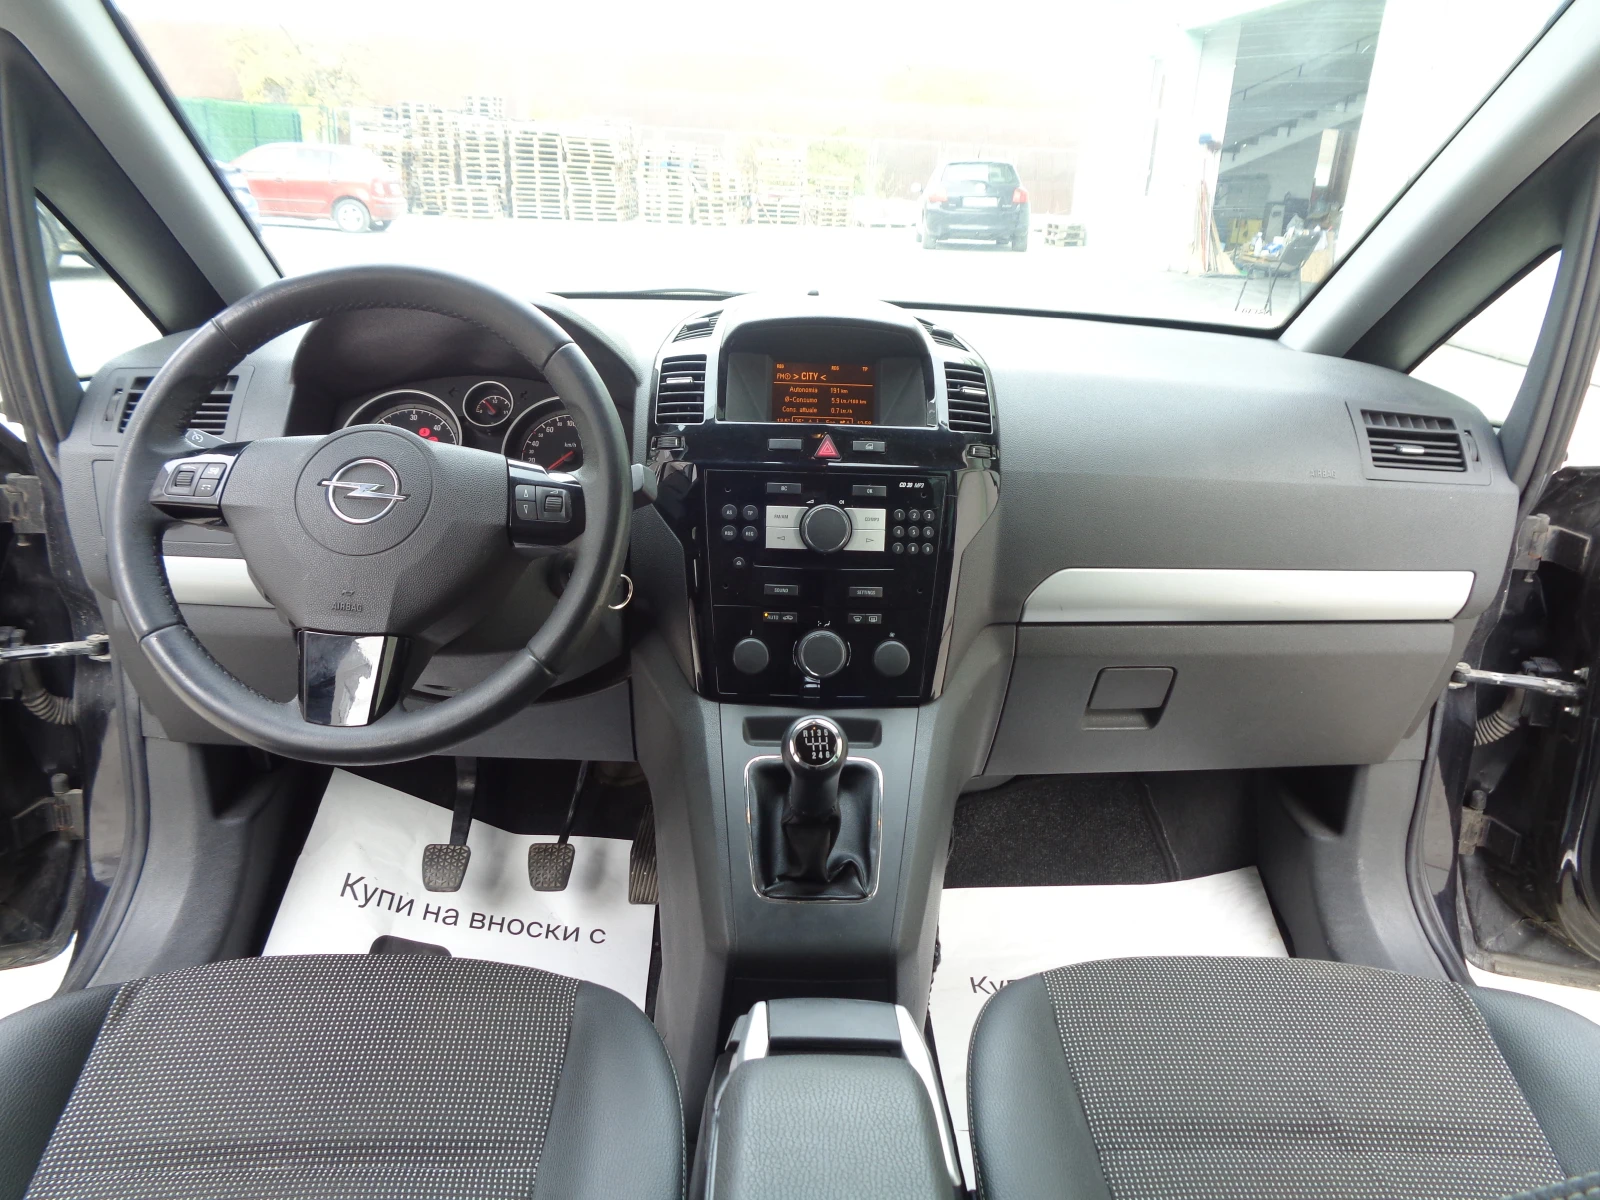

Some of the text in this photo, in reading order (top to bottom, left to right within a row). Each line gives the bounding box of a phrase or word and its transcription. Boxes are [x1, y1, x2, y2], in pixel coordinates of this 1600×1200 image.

[801, 371, 819, 381] CITY
[433, 424, 442, 432] 40
[331, 602, 363, 612] AIRBAG
[339, 872, 608, 945] Купи на вноски с
